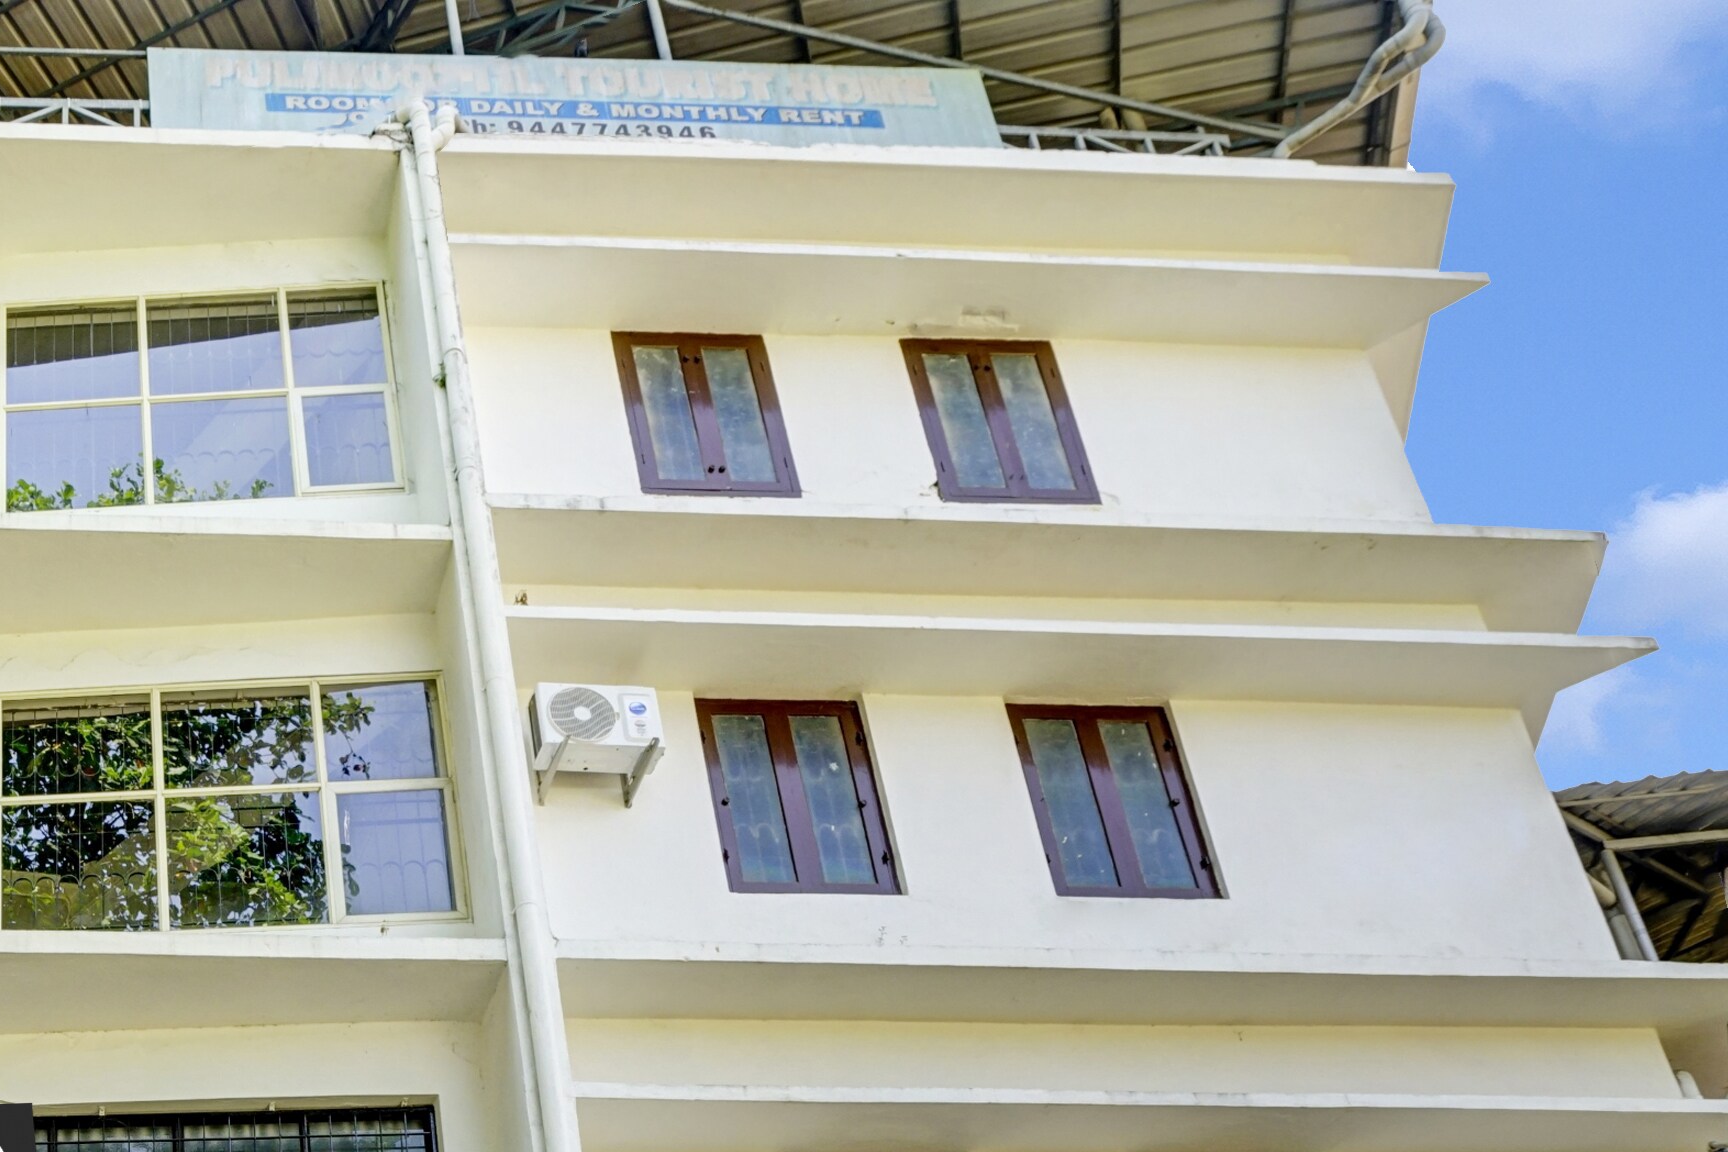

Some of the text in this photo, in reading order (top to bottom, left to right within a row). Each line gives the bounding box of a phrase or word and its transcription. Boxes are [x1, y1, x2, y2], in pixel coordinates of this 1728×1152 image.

[556, 64, 774, 102] TOURIST
[788, 71, 937, 108] HOME
[284, 94, 390, 111] ROOM
[472, 100, 565, 118] DAILY
[575, 102, 600, 118] &
[609, 103, 769, 123] MONTHLY
[777, 106, 866, 126] RENT
